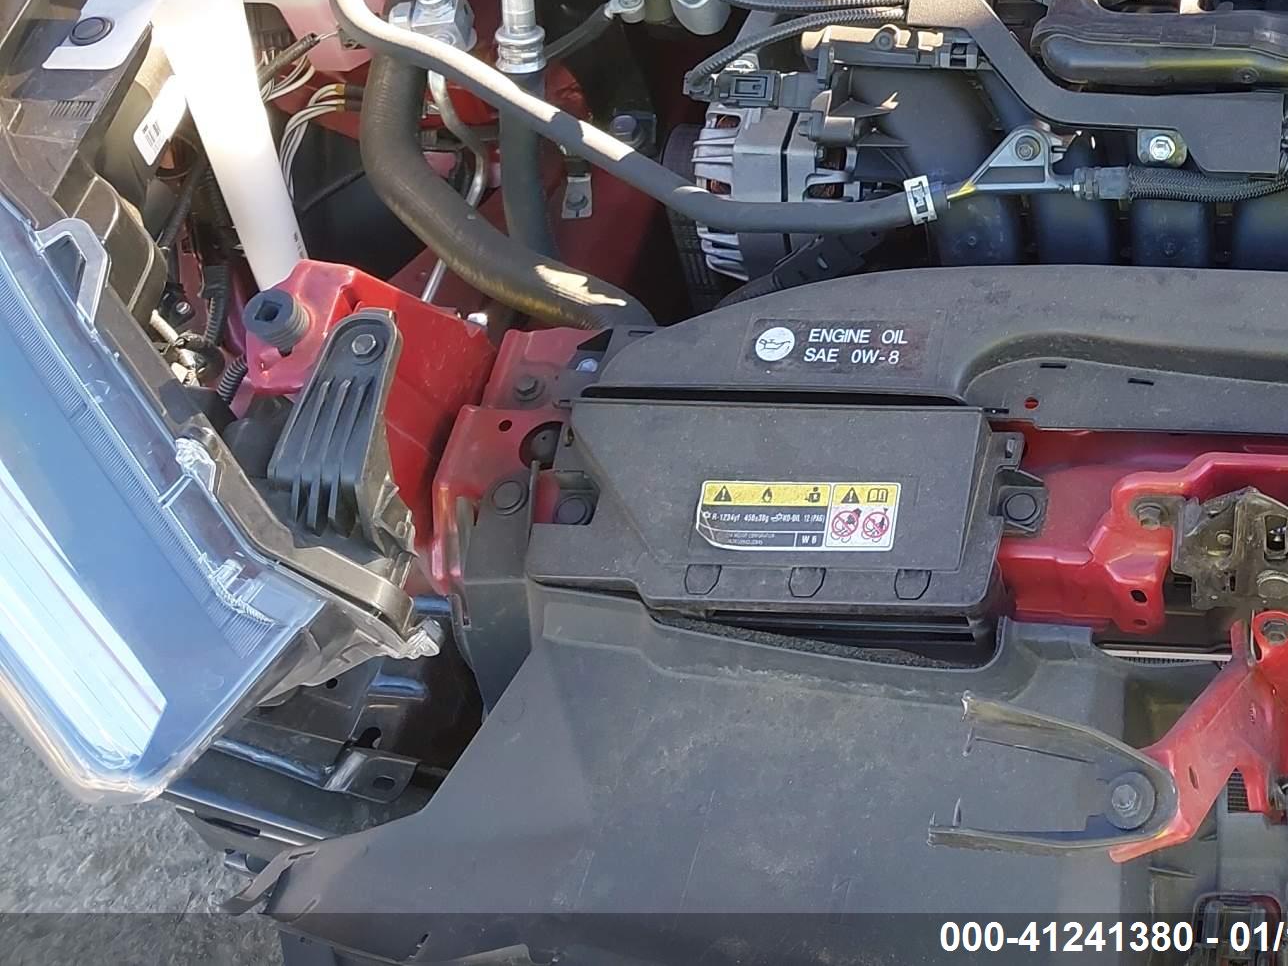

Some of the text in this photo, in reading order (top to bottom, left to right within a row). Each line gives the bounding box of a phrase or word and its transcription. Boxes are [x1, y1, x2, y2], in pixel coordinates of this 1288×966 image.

[808, 328, 908, 344] ENGINE OIL
[803, 347, 900, 365] SAE 0W-8
[801, 535, 810, 544] W
